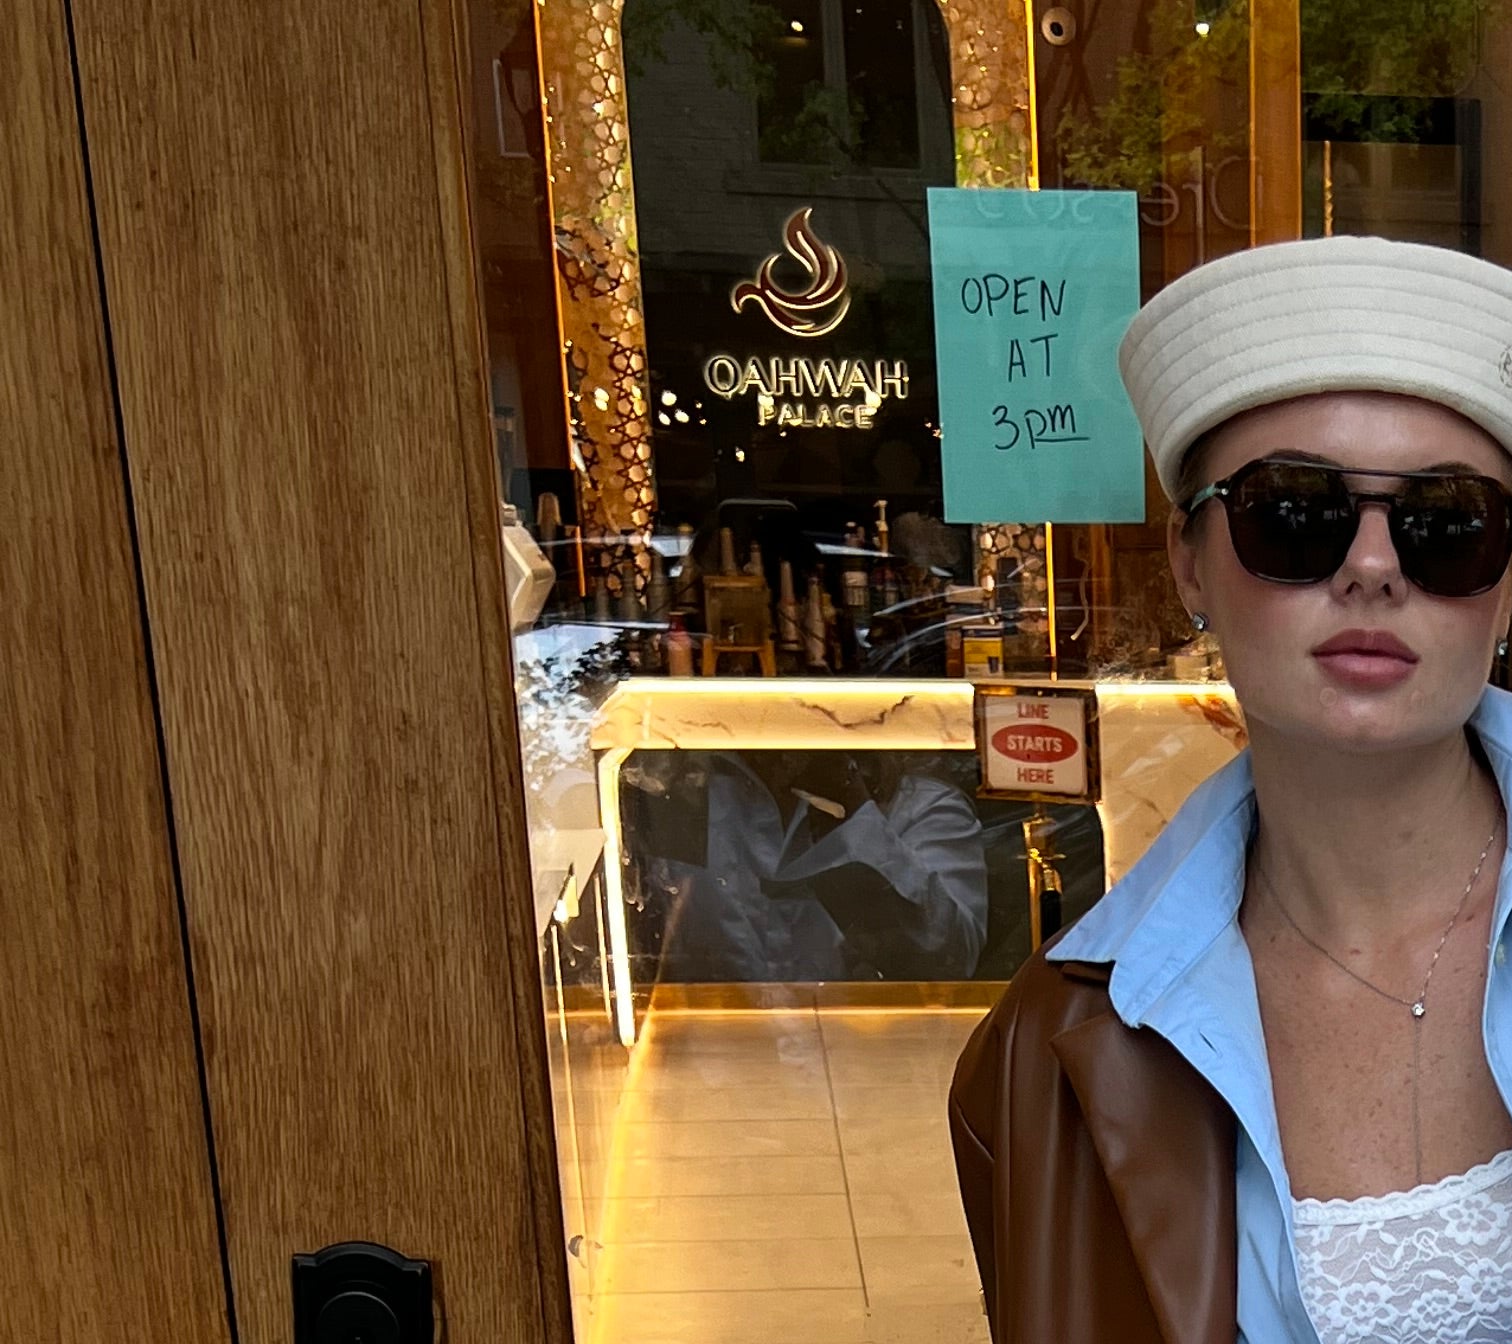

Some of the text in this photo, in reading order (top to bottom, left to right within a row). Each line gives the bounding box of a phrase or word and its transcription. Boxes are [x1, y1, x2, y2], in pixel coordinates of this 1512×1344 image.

[961, 273, 1066, 322] OPEN
[1008, 334, 1059, 382] AT
[758, 403, 875, 429] PALACE
[992, 404, 1083, 450] 3pm
[1016, 703, 1050, 719] LINE
[1006, 734, 1063, 752] STARTS
[1016, 767, 1055, 784] HERE
